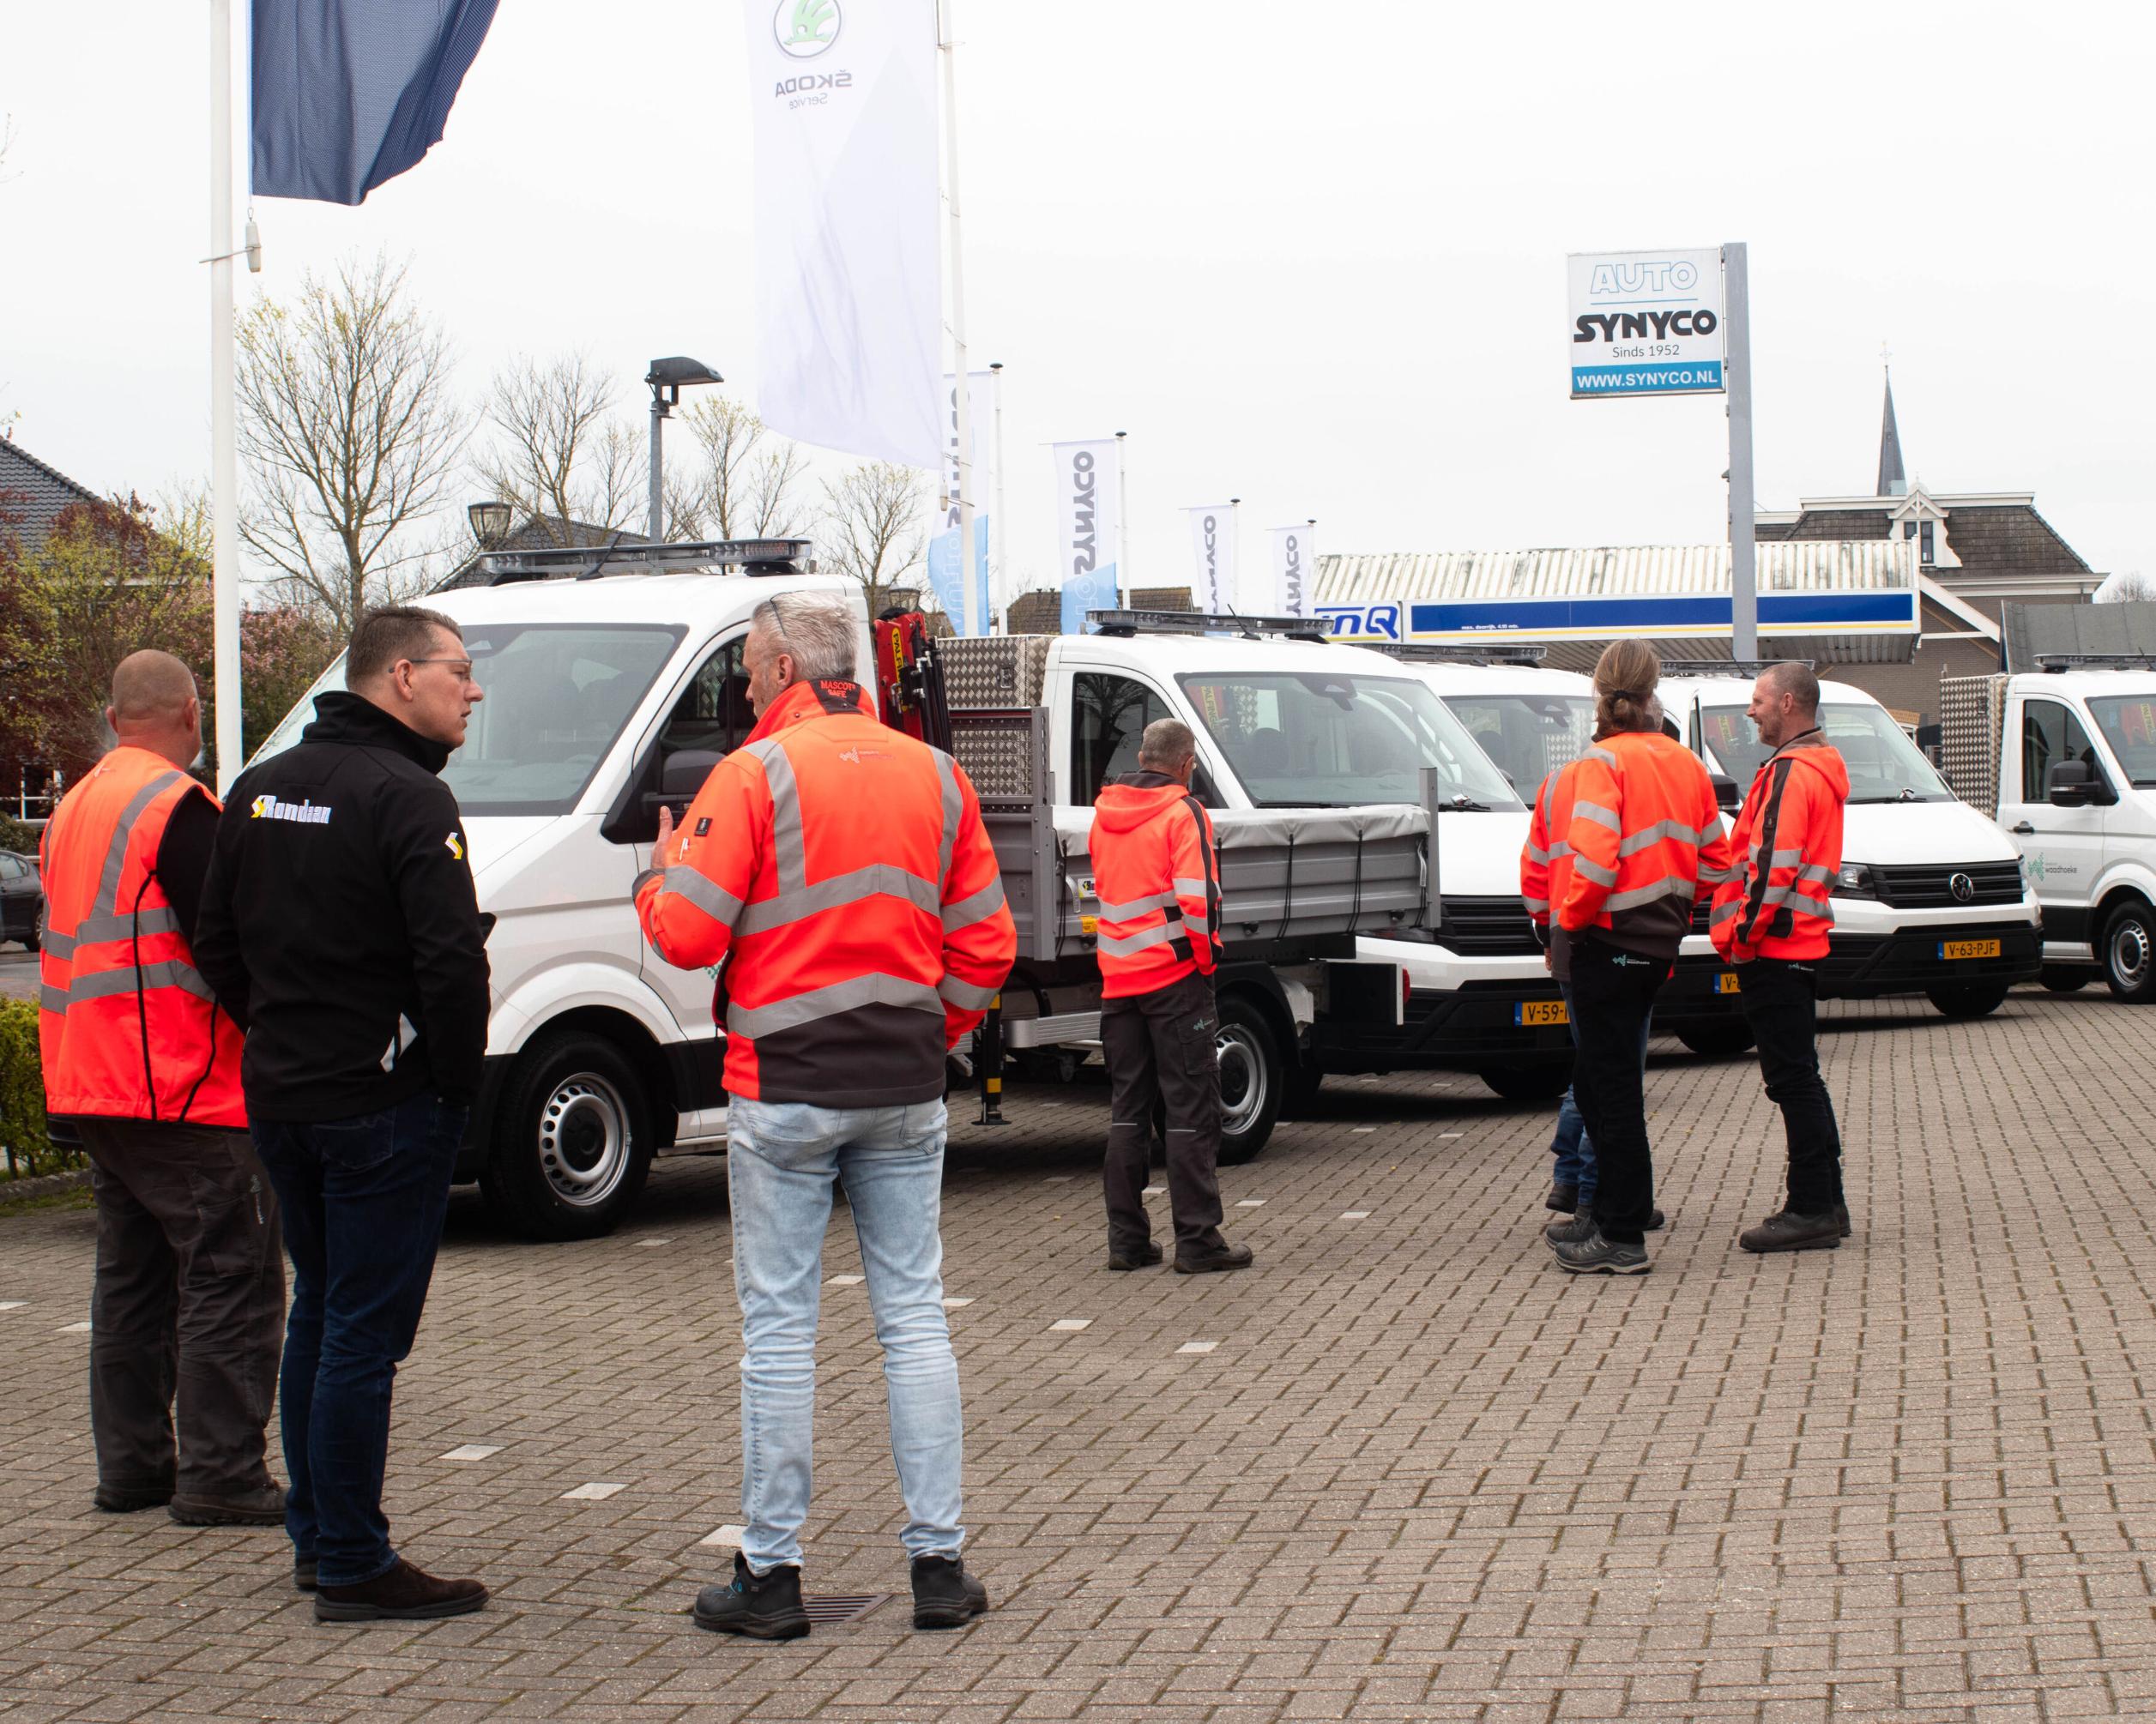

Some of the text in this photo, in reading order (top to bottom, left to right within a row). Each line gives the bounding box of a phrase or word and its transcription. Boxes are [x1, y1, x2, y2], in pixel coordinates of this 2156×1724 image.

[1590, 262, 1698, 294] AUTO
[1573, 310, 1717, 343] SYNYCO
[1612, 344, 1680, 358] Sinds 1952
[1577, 371, 1718, 389] WWW.SYNYCO.NL
[827, 689, 848, 698] SAFE
[1948, 942, 1995, 956] V-63-PJF
